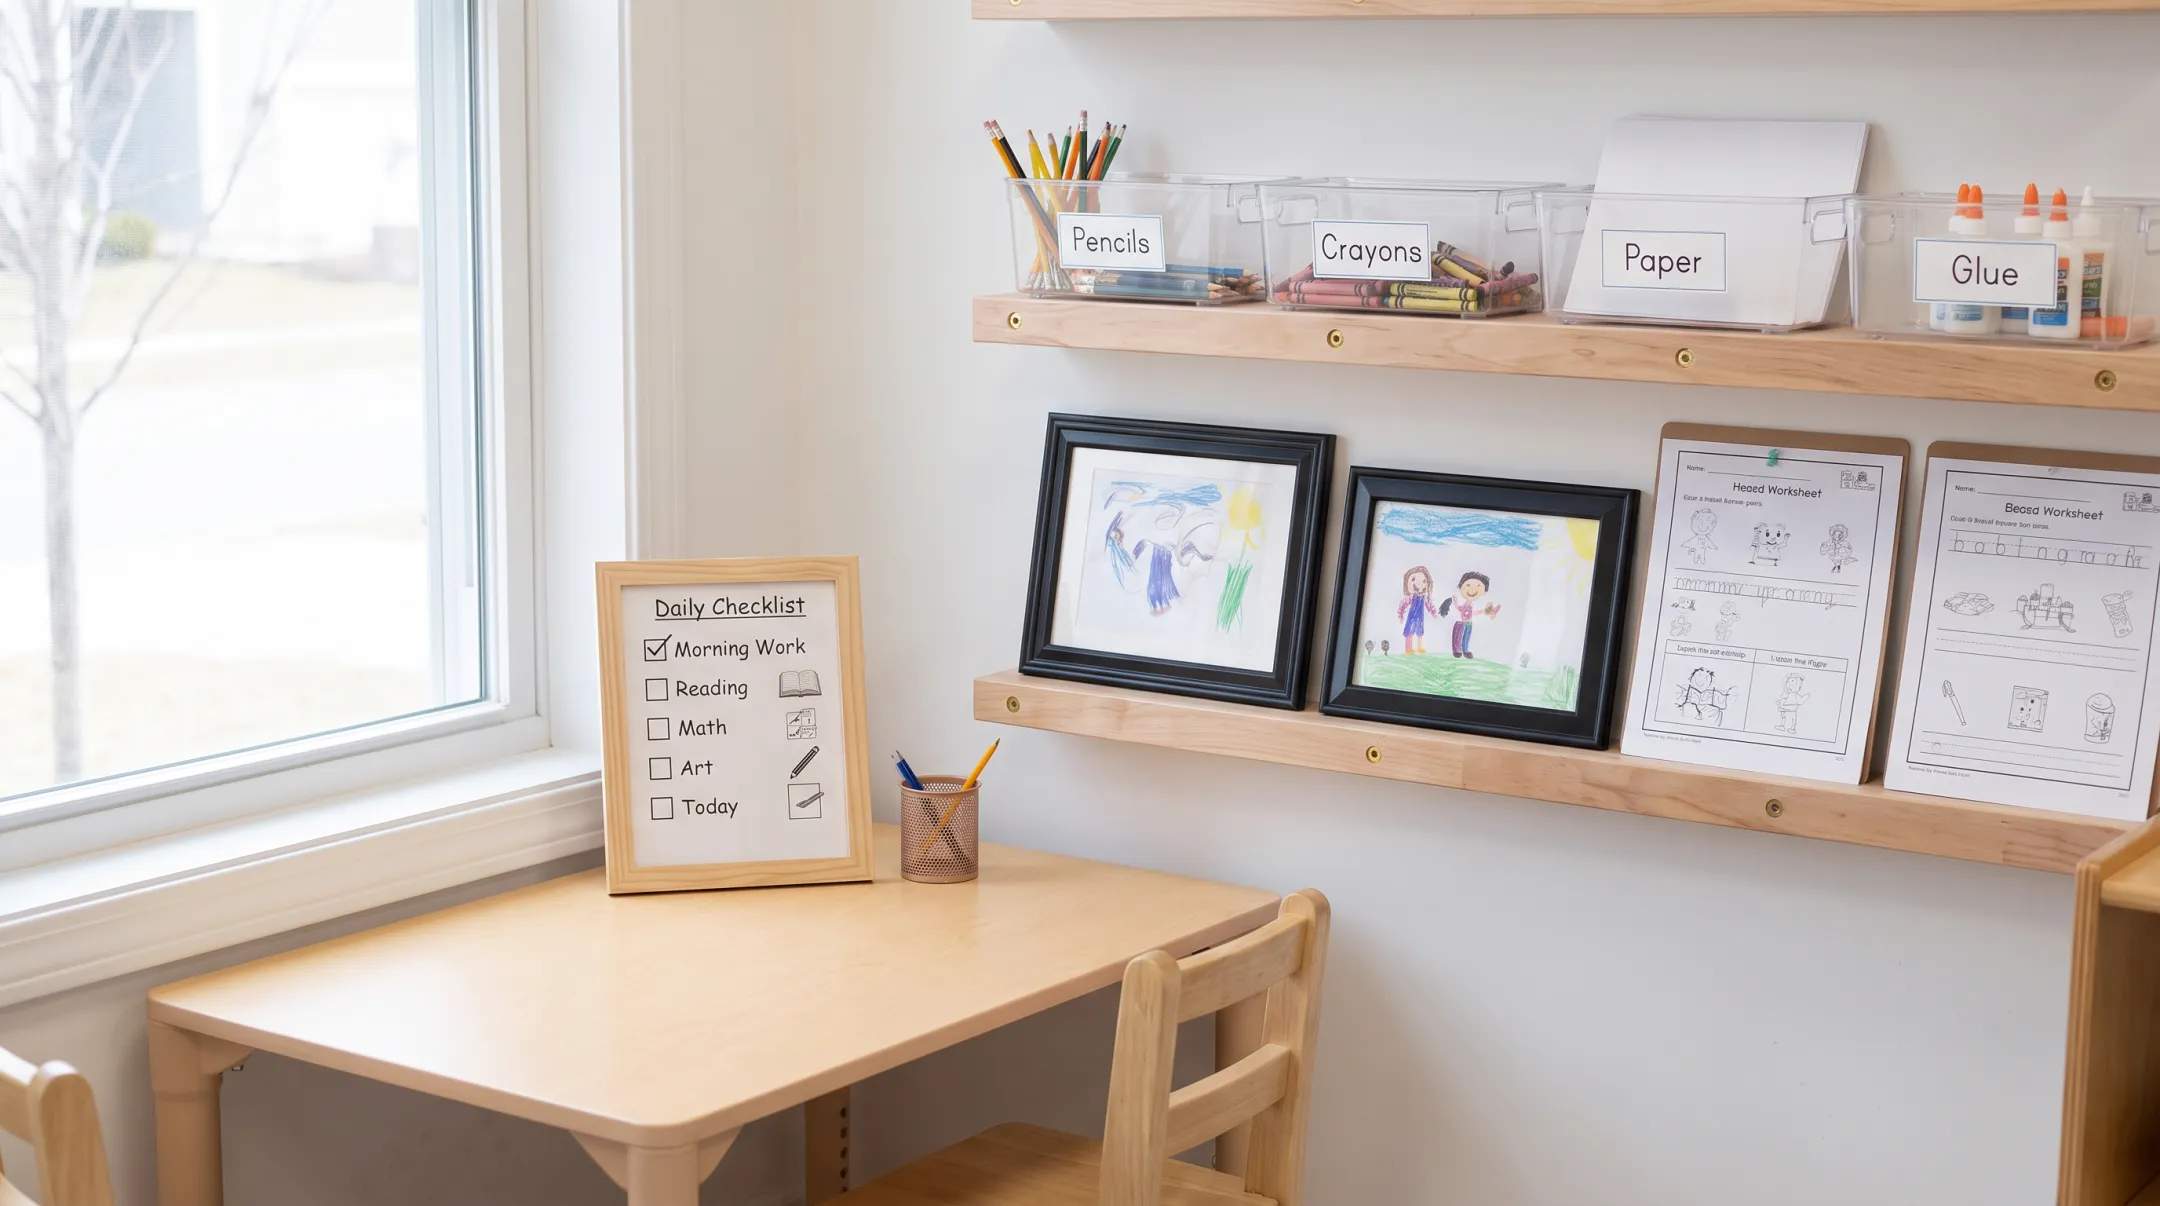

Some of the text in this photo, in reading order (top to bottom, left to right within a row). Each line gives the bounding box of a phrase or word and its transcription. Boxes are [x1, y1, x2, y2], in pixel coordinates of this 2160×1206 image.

[1073, 226, 1150, 254] Pencils
[1321, 233, 1422, 268] Crayons
[1625, 243, 1702, 279] Paper
[1952, 255, 2019, 287] Glue
[1686, 464, 1706, 472] Name:
[1768, 485, 1822, 499] Worksheet
[1954, 484, 1976, 493] Name:
[2043, 506, 2104, 520] Worksheet
[655, 596, 806, 621] Daily Checklist
[674, 638, 806, 661] Morning Work
[676, 679, 748, 700] Reading
[678, 718, 727, 737] Math
[680, 760, 714, 776] Art
[681, 798, 739, 819] Today
